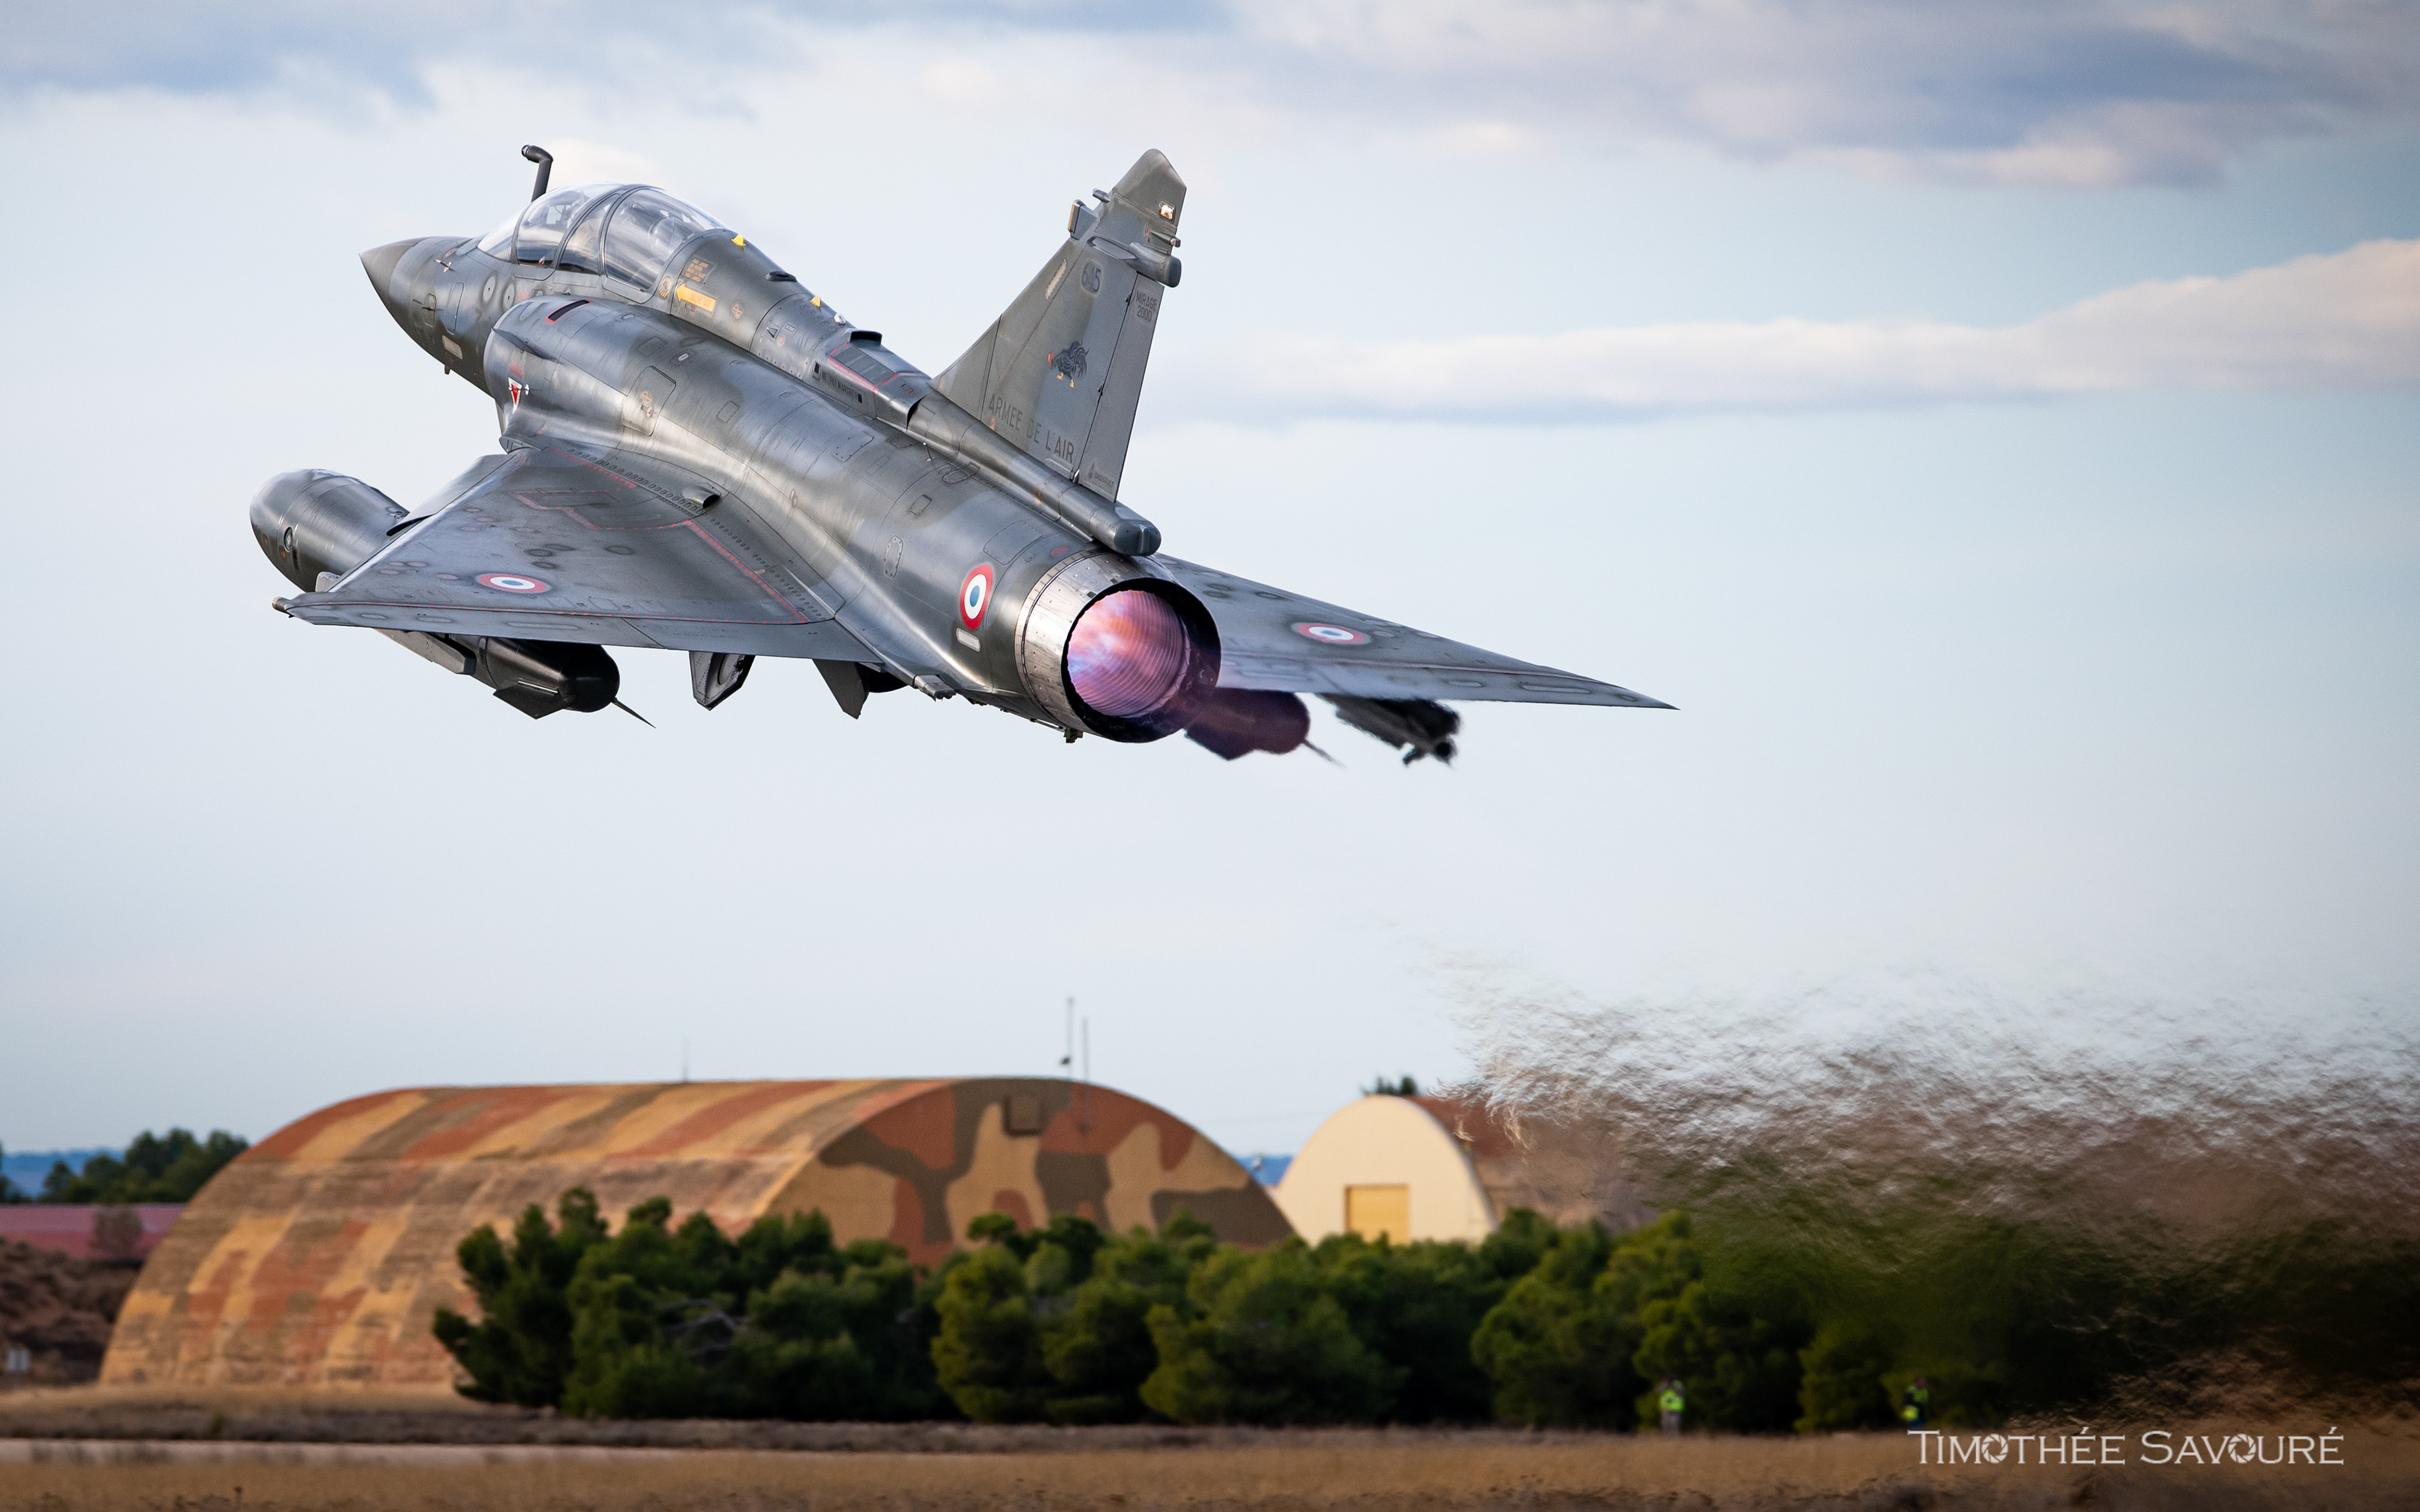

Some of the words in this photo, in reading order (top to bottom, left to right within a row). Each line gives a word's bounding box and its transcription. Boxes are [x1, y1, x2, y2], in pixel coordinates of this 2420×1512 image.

[1081, 261, 1102, 293] 645
[1136, 291, 1158, 311] MIRAGE
[1136, 304, 1153, 322] 2000
[988, 393, 1023, 432] ARMEE
[1026, 418, 1042, 444] DE
